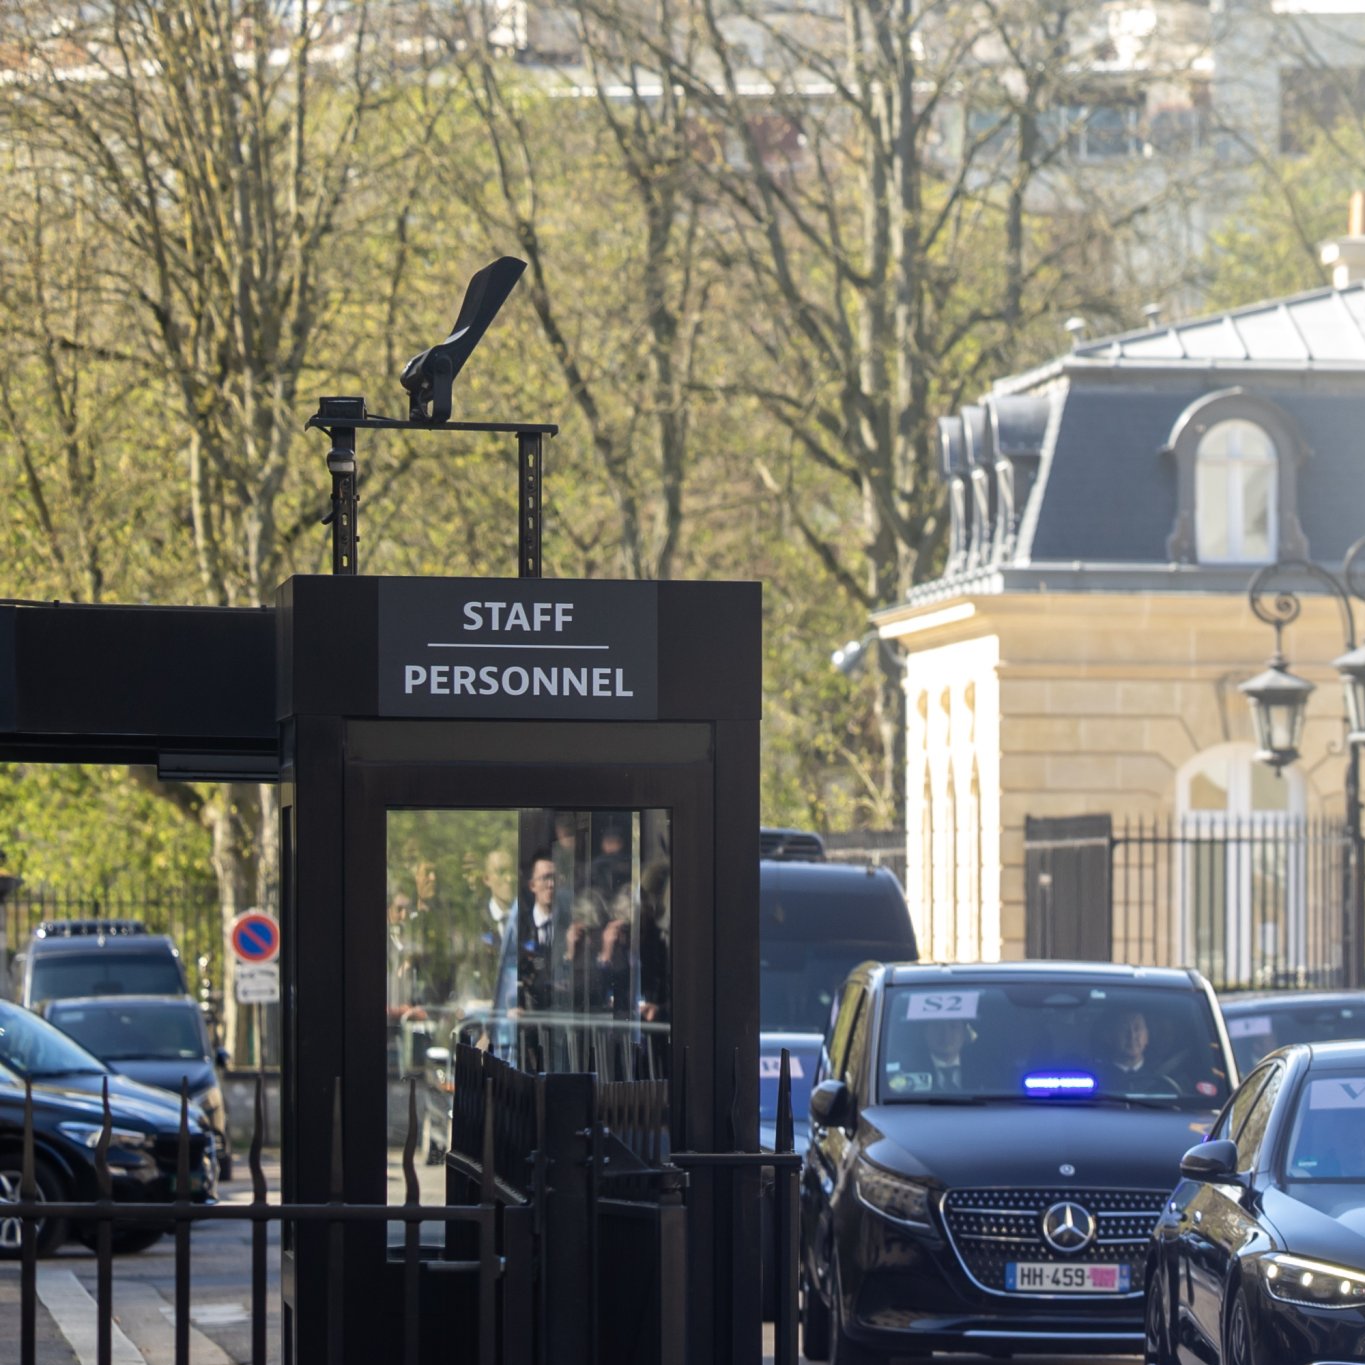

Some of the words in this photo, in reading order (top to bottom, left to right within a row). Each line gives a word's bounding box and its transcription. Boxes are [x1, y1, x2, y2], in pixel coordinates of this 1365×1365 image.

[462, 601, 575, 632] STAFF
[404, 665, 635, 698] PERSONNEL
[922, 995, 963, 1012] S2
